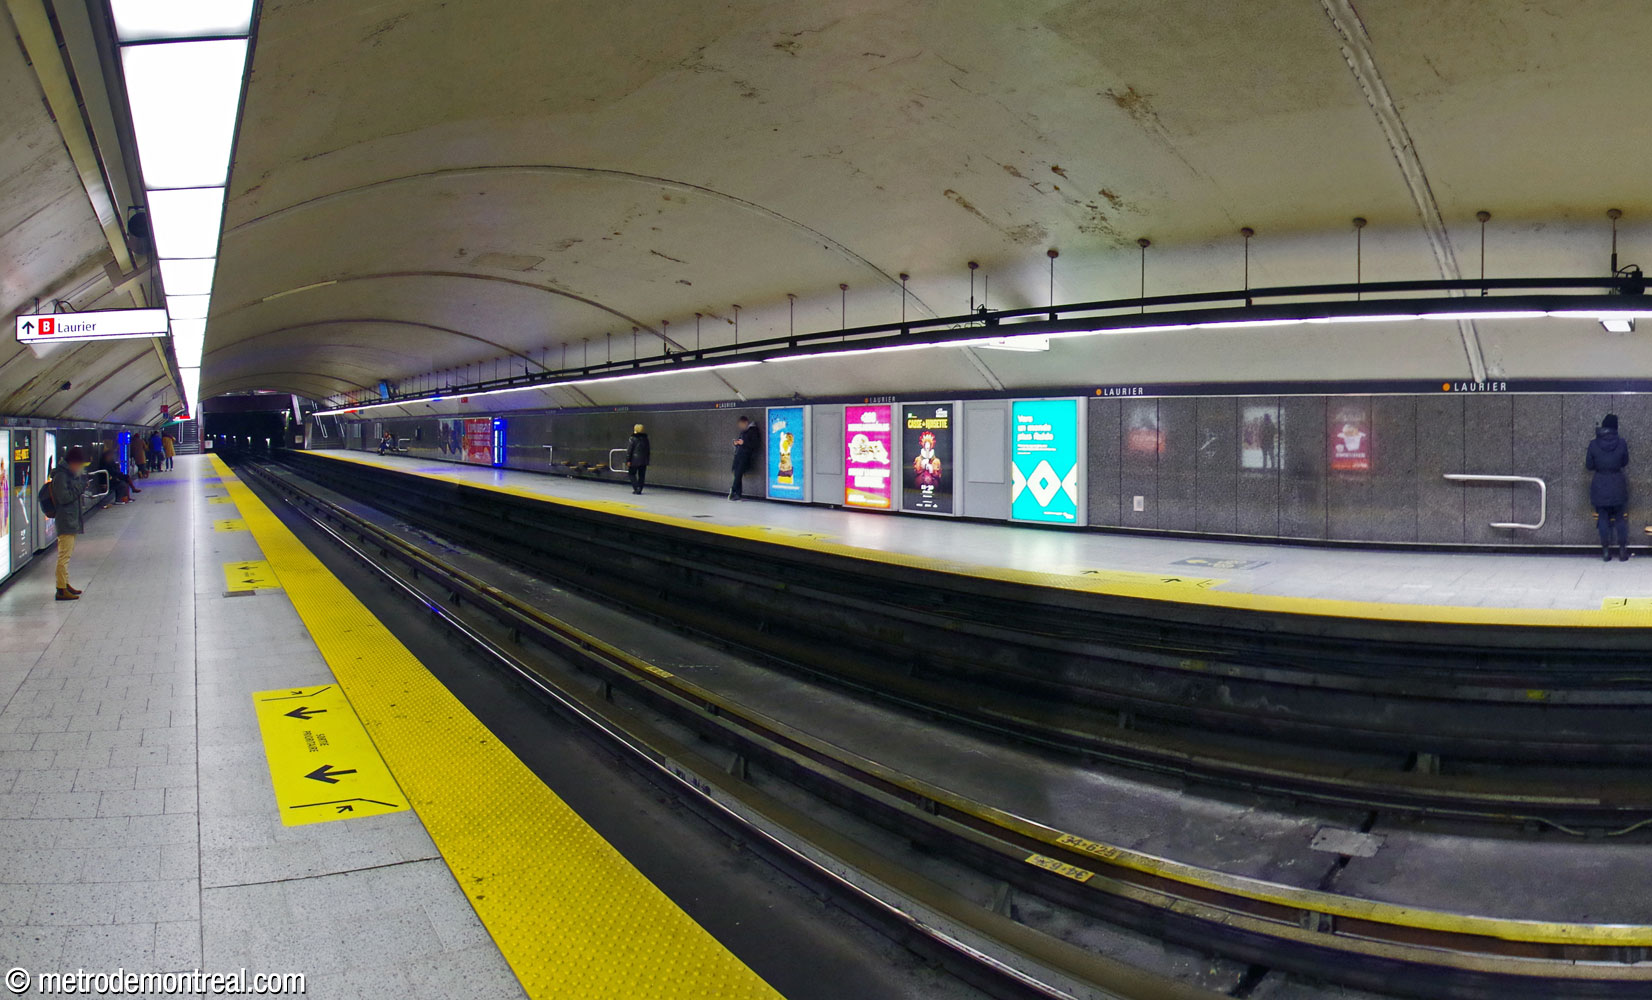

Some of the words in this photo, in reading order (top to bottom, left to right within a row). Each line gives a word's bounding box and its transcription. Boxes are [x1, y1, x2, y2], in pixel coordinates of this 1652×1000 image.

[43, 321, 51, 332] B
[58, 321, 96, 333] Laurier
[1104, 387, 1144, 396] LAURIER
[1454, 382, 1506, 392] LAURIER
